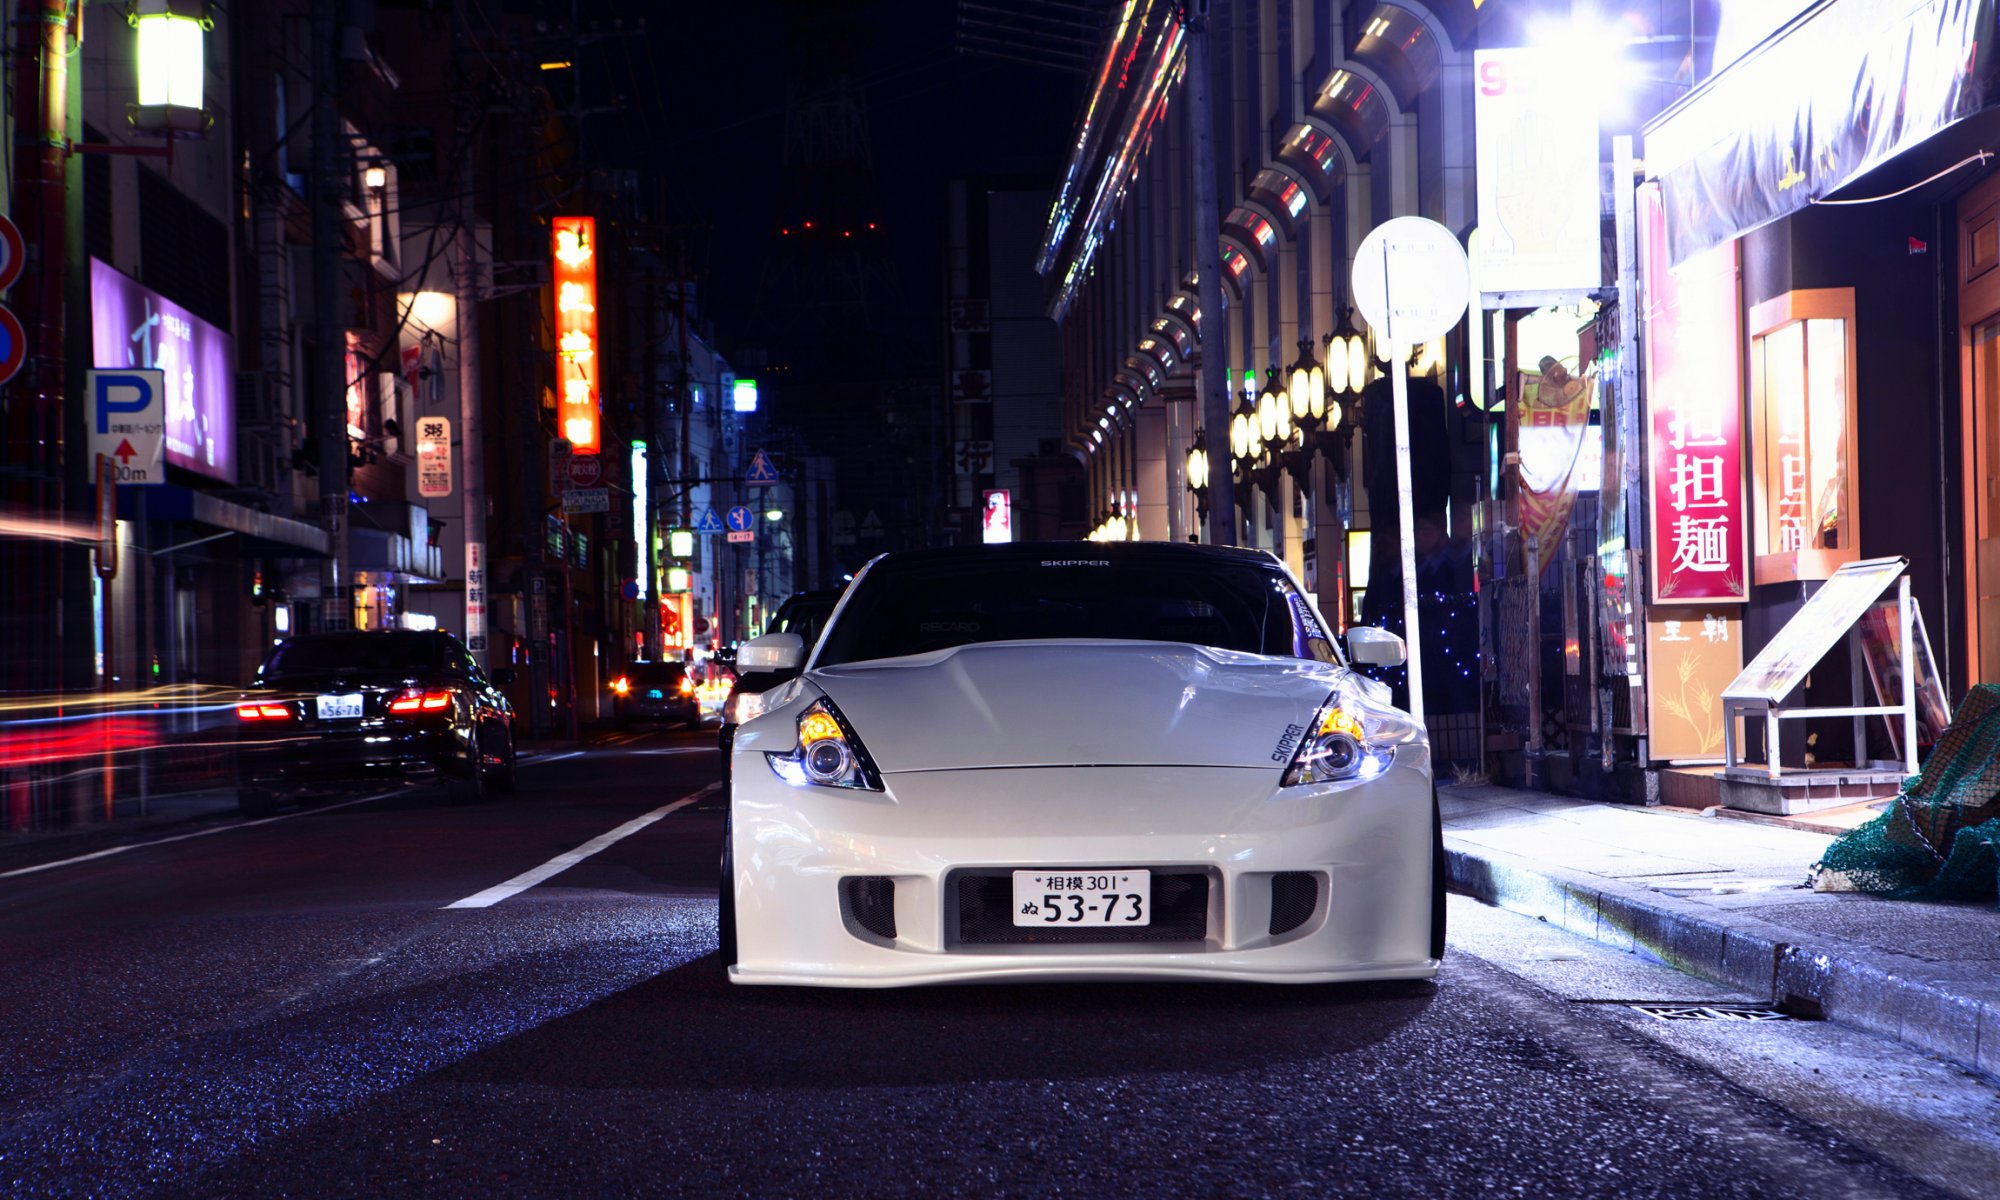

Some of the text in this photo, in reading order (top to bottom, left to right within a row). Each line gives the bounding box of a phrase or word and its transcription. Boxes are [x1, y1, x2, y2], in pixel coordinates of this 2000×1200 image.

[96, 375, 152, 434] P
[1271, 723, 1304, 764] SKIPPER
[1046, 876, 1116, 890] 相模 301
[1021, 894, 1142, 922] ぬ 53-73
